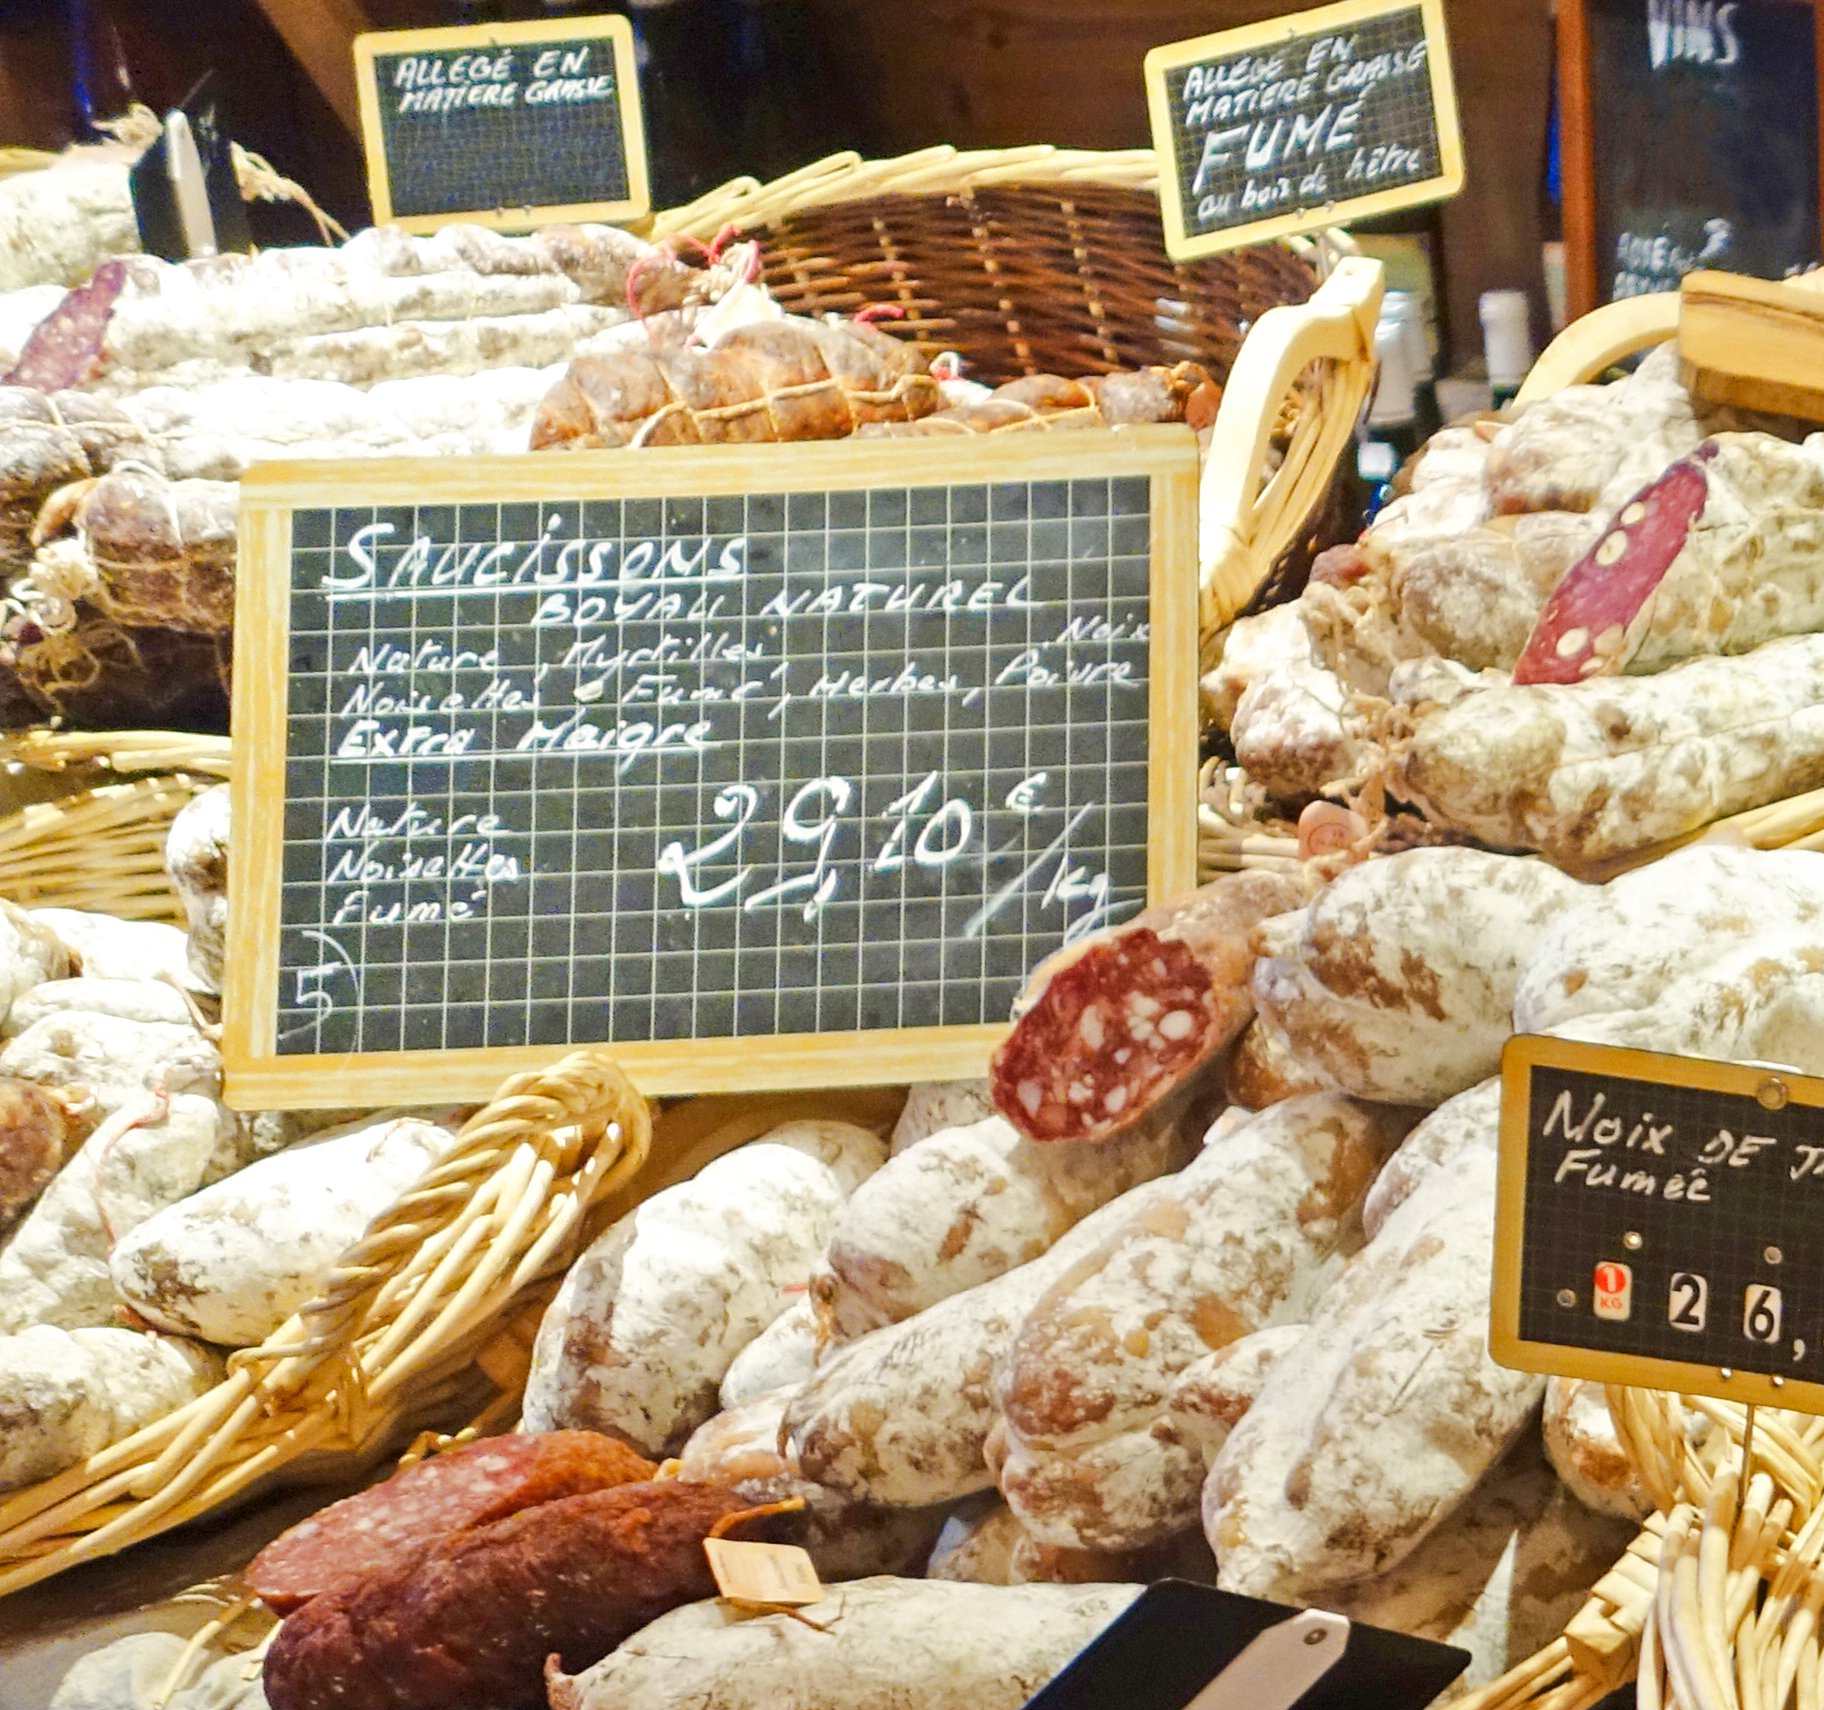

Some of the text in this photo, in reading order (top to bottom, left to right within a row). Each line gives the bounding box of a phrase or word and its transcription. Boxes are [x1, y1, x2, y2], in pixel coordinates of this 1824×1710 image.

[534, 47, 590, 77] EN
[1305, 35, 1359, 74] EN
[1193, 82, 1376, 196] FUMÉ
[1197, 143, 1421, 221] au bois de hêtre
[531, 575, 1043, 626] BOYAU NATUREL
[996, 648, 1139, 687] Poivre
[337, 708, 712, 776] Extra Maigre
[326, 802, 512, 841] Nature
[328, 840, 520, 884] Noisettes
[333, 890, 488, 925] Fumé
[1696, 1128, 1777, 1168] DE
